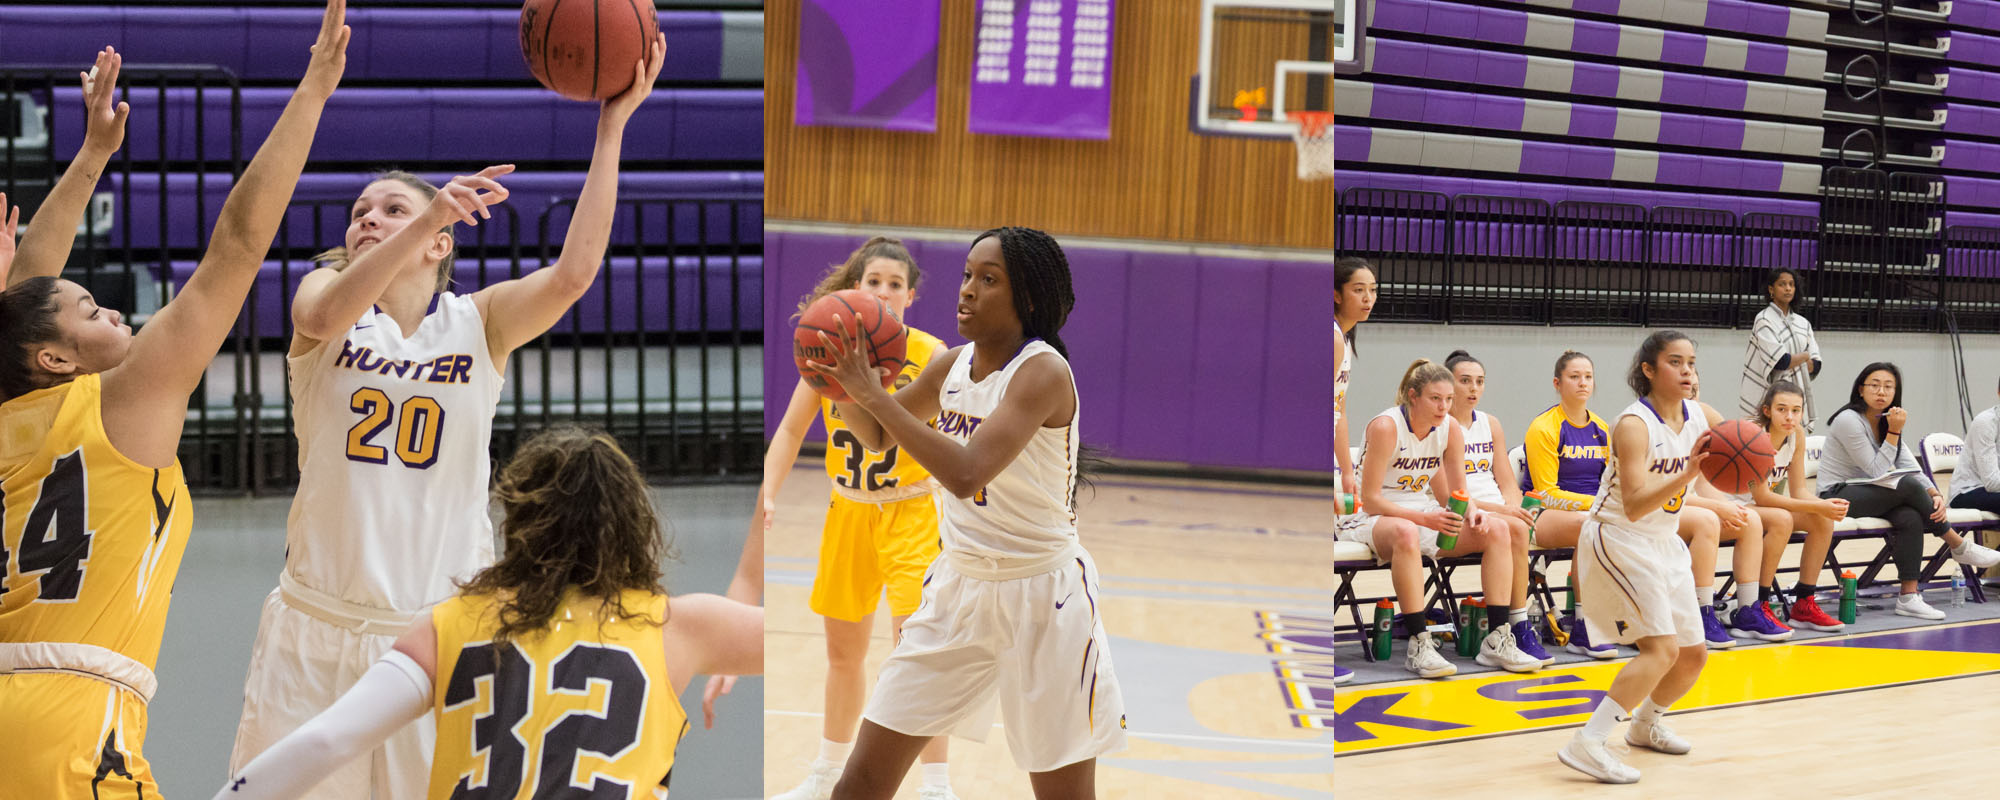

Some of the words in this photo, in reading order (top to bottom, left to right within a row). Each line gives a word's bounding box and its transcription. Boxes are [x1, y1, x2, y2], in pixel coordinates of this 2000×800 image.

[346, 387, 445, 470] 20
[937, 409, 985, 439] HUNT
[1465, 442, 1494, 454] NTER
[832, 428, 898, 491] 32
[1648, 456, 1690, 474] HUN
[0, 445, 96, 603] 4
[442, 640, 650, 800] 32
